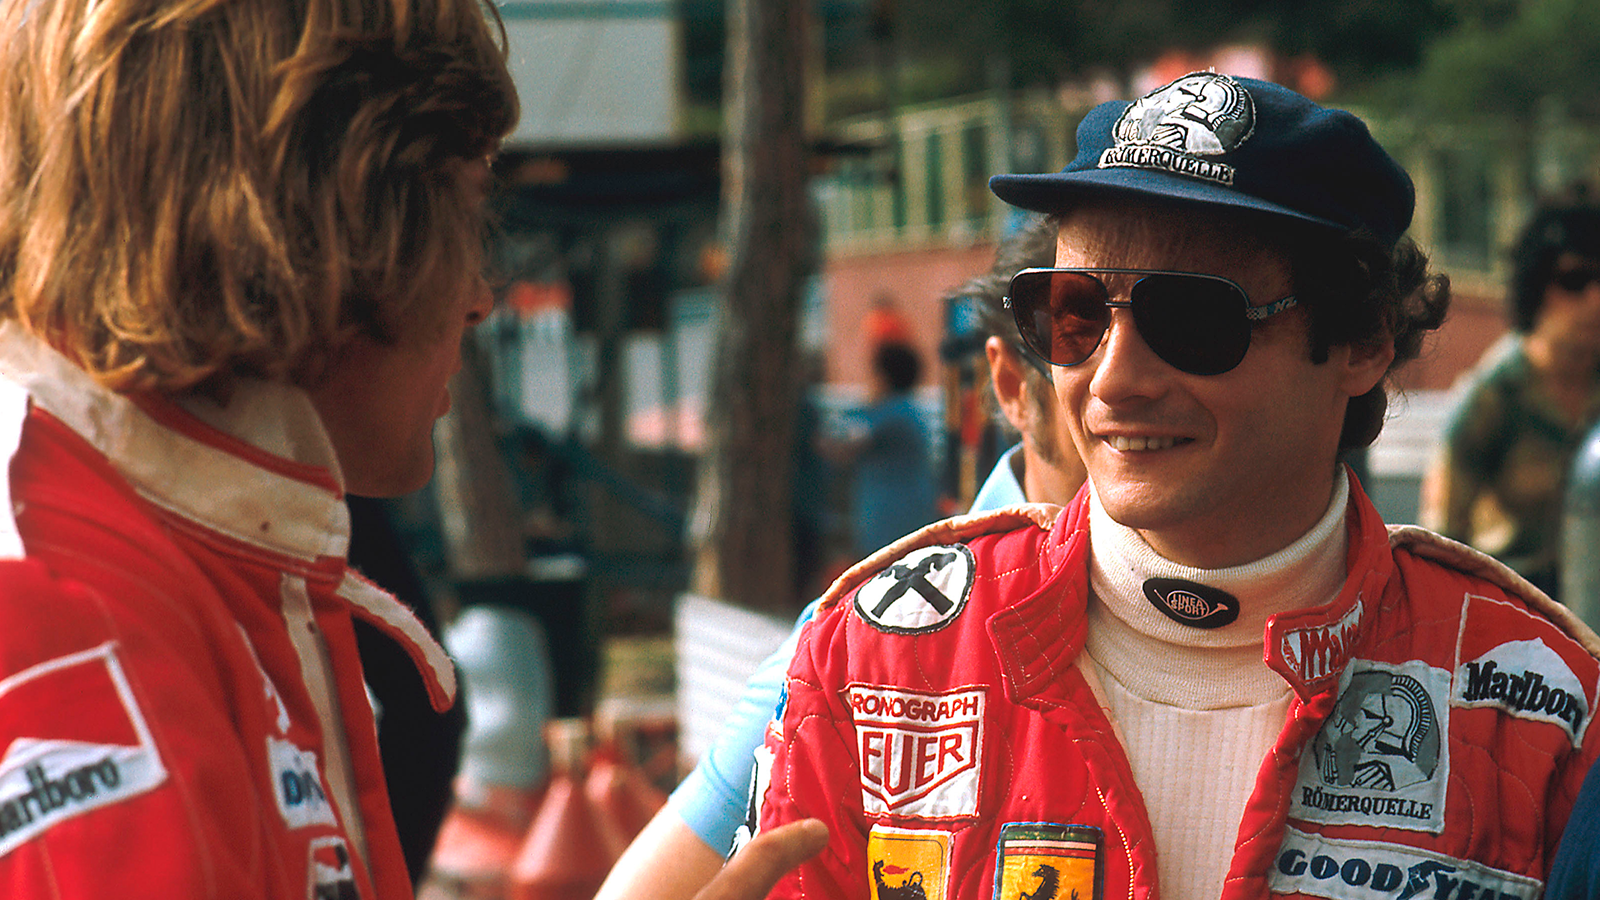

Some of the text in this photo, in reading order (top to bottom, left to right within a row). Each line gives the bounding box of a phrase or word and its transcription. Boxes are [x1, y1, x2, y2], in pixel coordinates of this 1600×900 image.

[1170, 599, 1206, 616] SPORT
[1172, 593, 1205, 608] LINEA
[1301, 786, 1433, 820] RÖMERQUELLE
